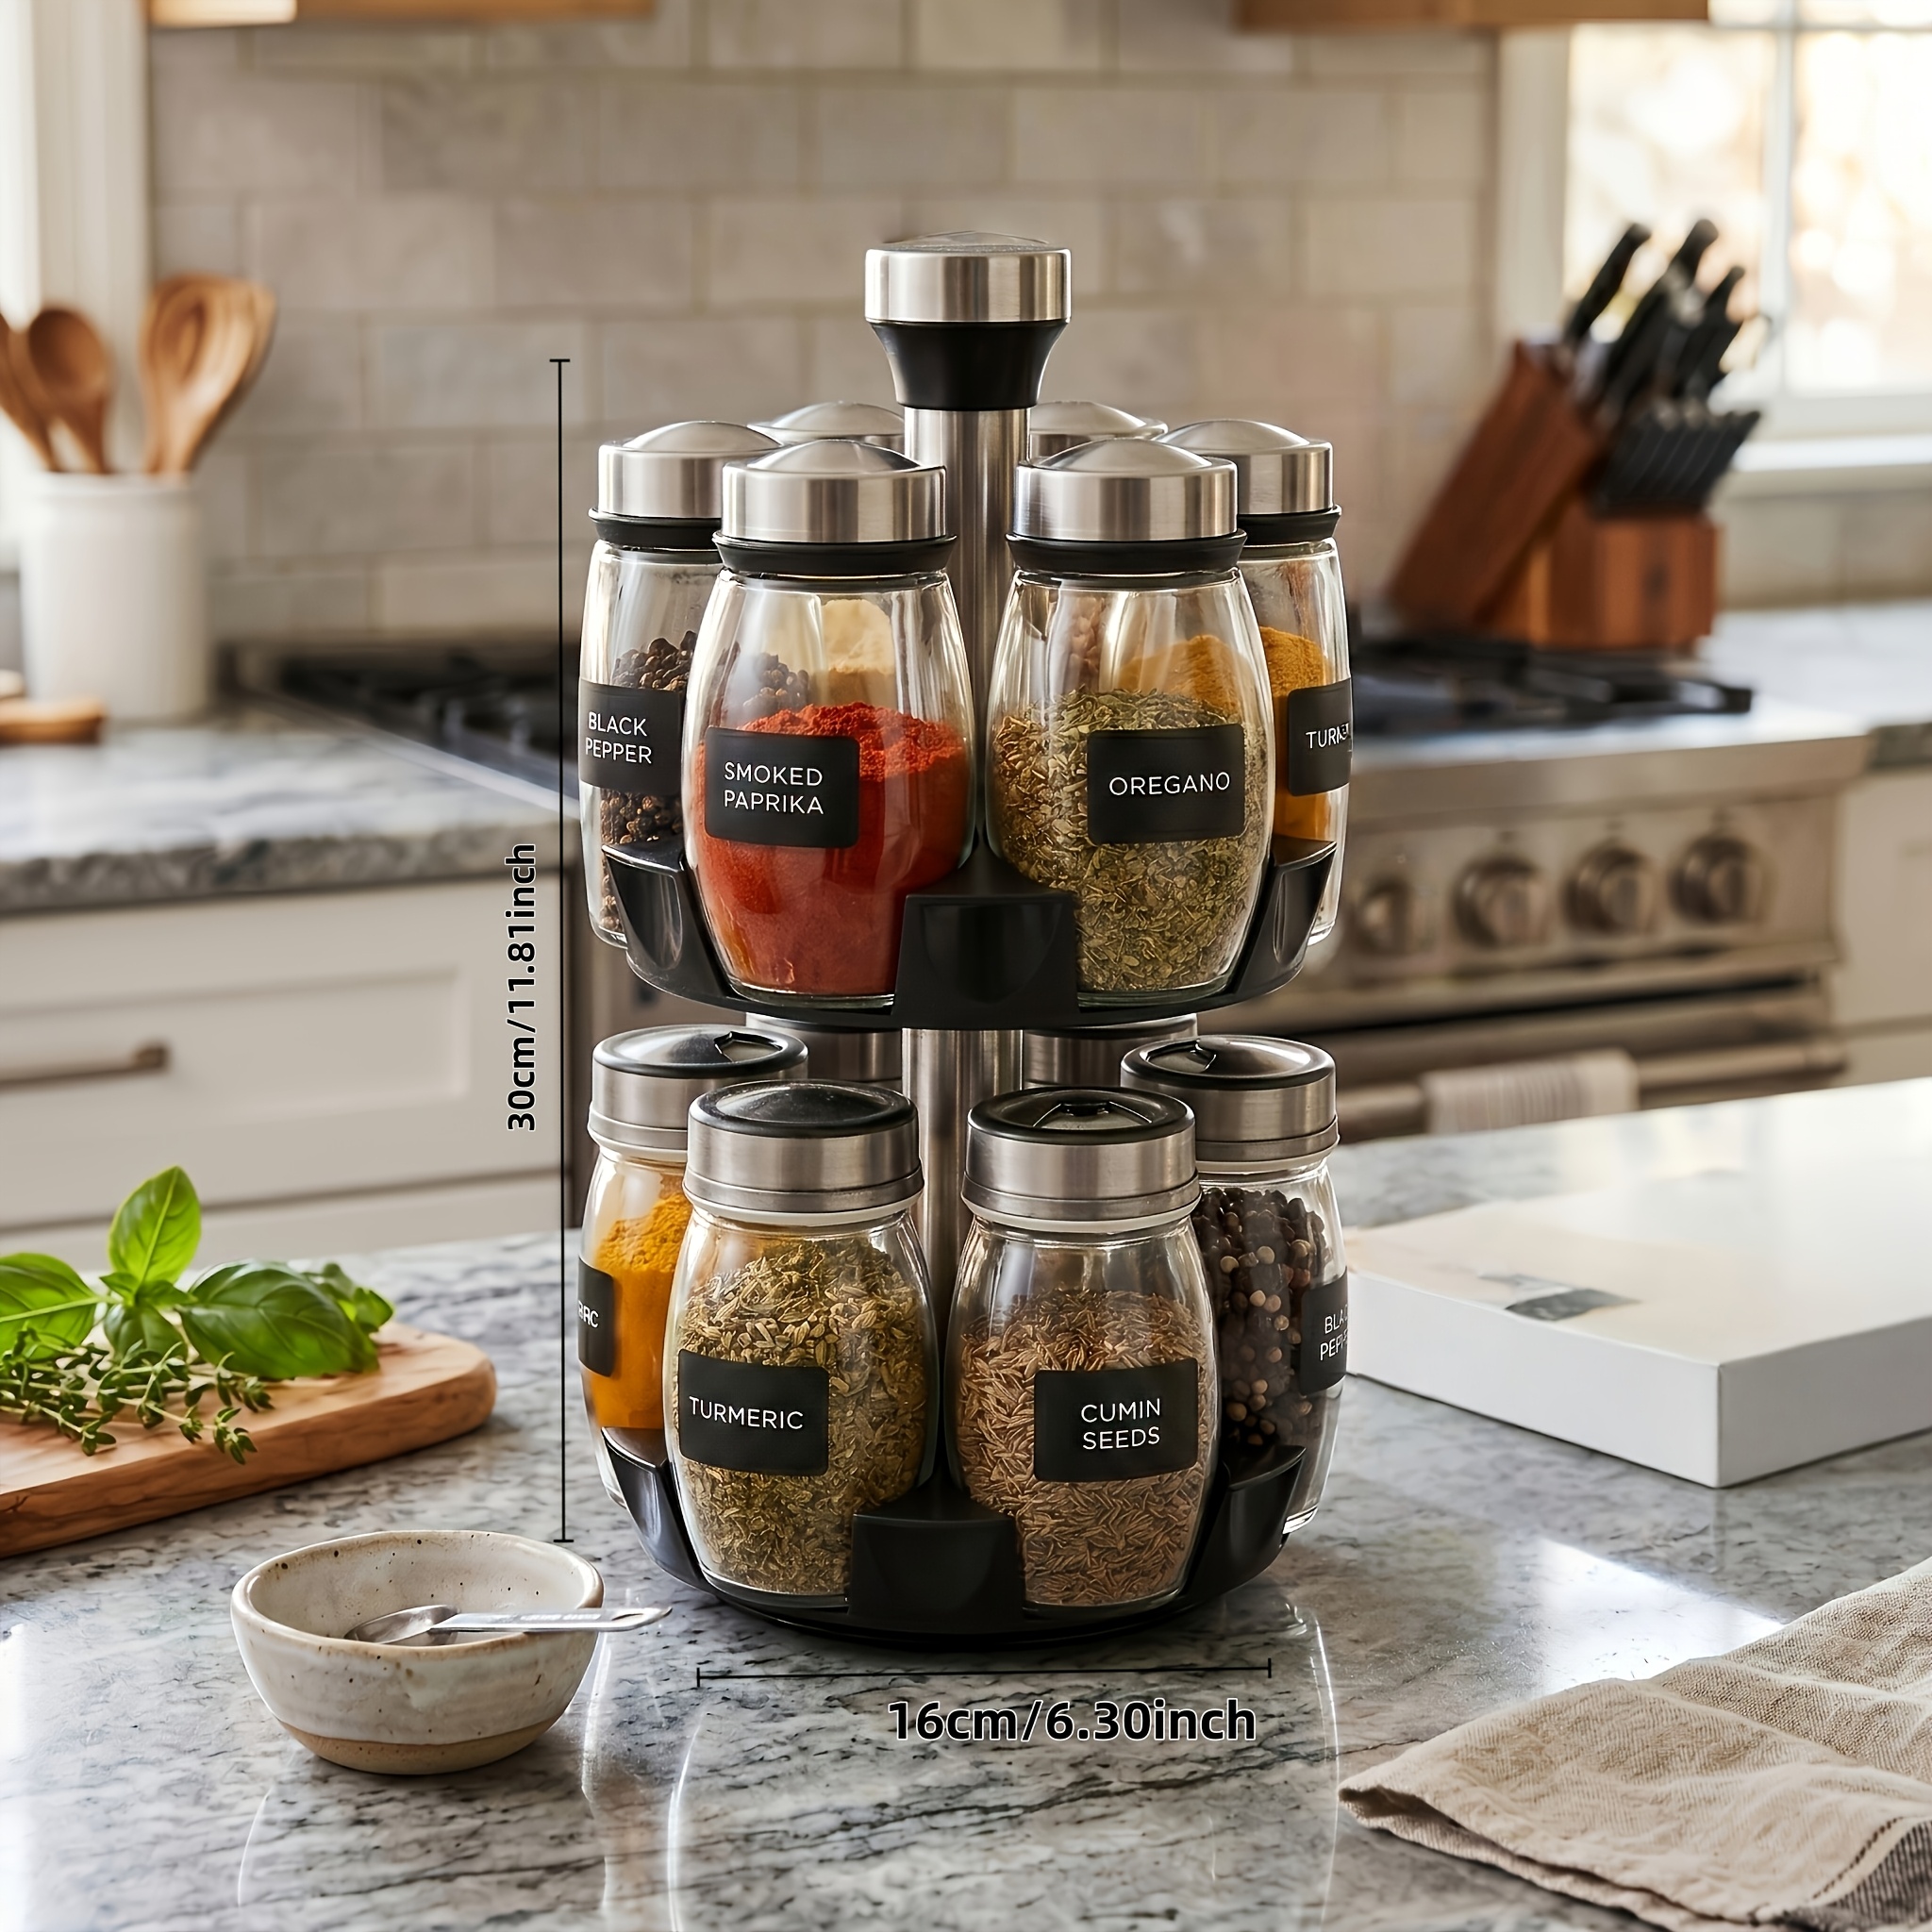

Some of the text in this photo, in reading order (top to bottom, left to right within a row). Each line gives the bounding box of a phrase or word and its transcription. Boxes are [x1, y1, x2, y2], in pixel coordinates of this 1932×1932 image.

[588, 710, 648, 737] BLACK
[585, 739, 652, 764] PEPPER
[724, 761, 824, 787] SMOKED
[1108, 771, 1231, 795] OREGANO
[724, 789, 824, 815] PAPRIKA
[689, 1395, 804, 1430] TURMERIC
[1080, 1397, 1161, 1423] CUMIN
[1082, 1425, 1160, 1450] SEEDS
